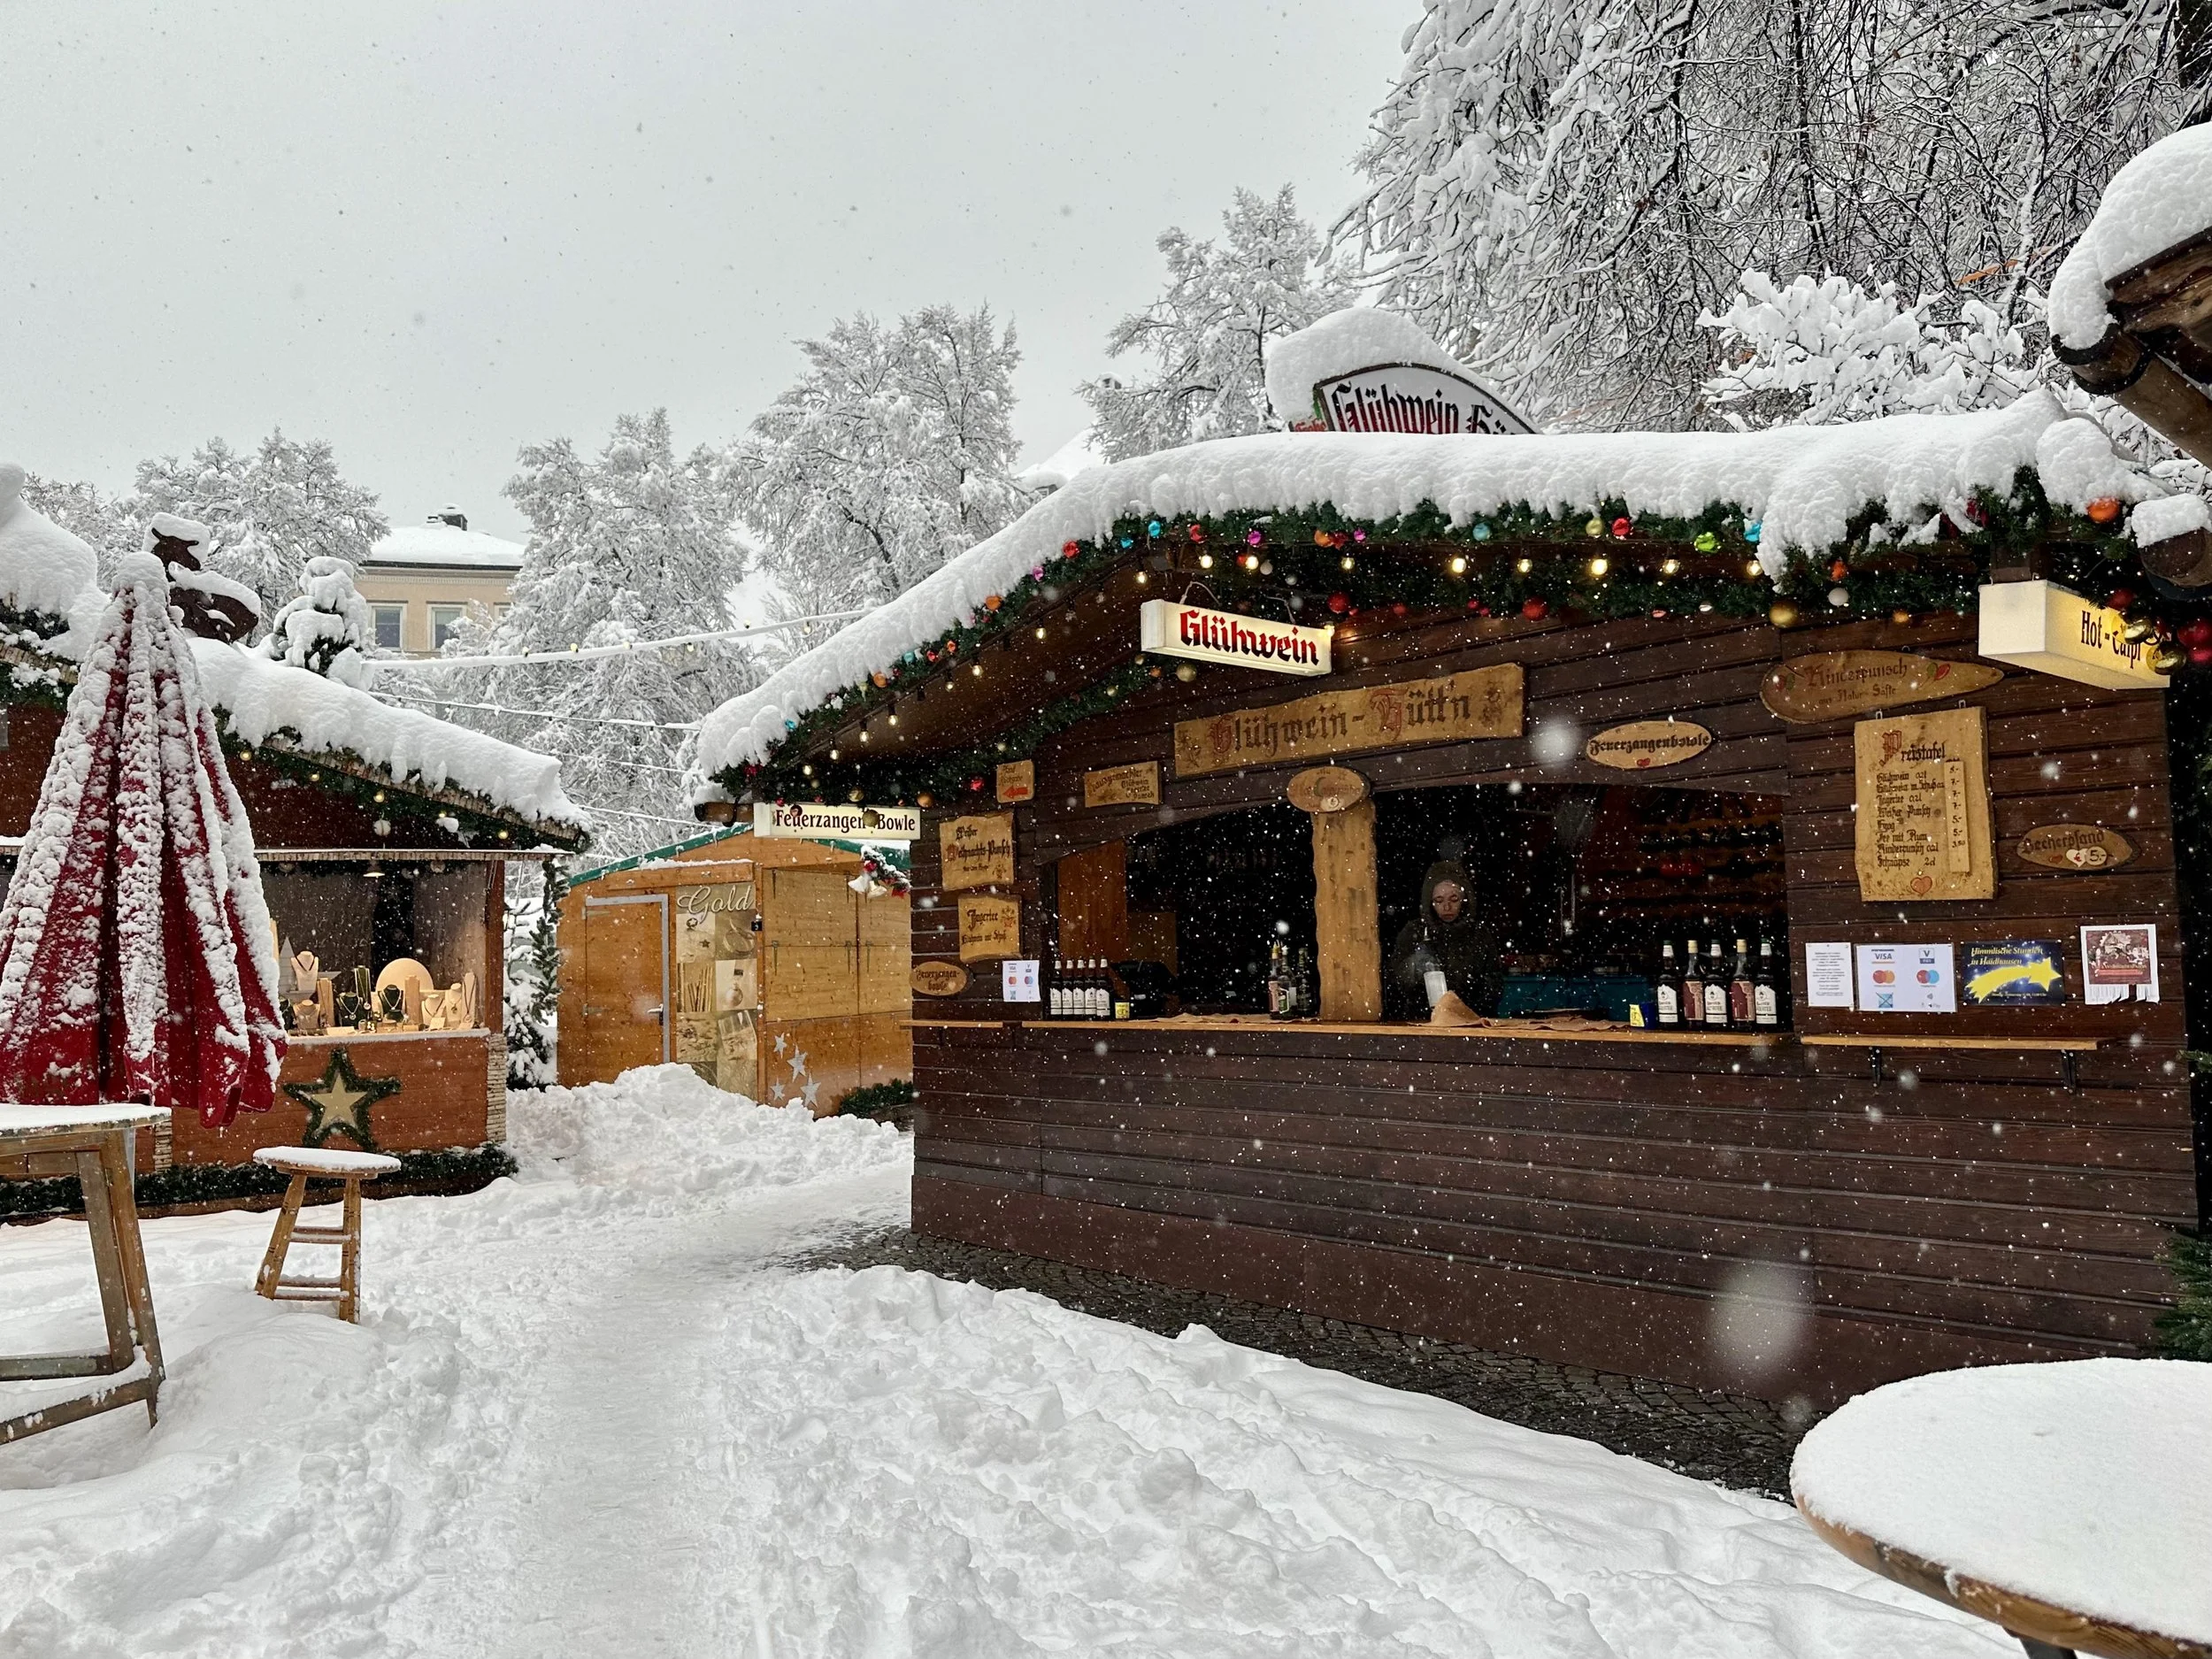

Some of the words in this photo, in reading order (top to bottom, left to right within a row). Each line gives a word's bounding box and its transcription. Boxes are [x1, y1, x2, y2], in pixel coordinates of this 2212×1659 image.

[1179, 610, 1319, 665] Glühwein
[877, 814, 916, 831] Bowle
[2022, 830, 2104, 855] Becherpfand
[677, 885, 754, 925] Gold
[1970, 947, 2012, 956] Himmlische
[2013, 945, 2044, 955] Stunden
